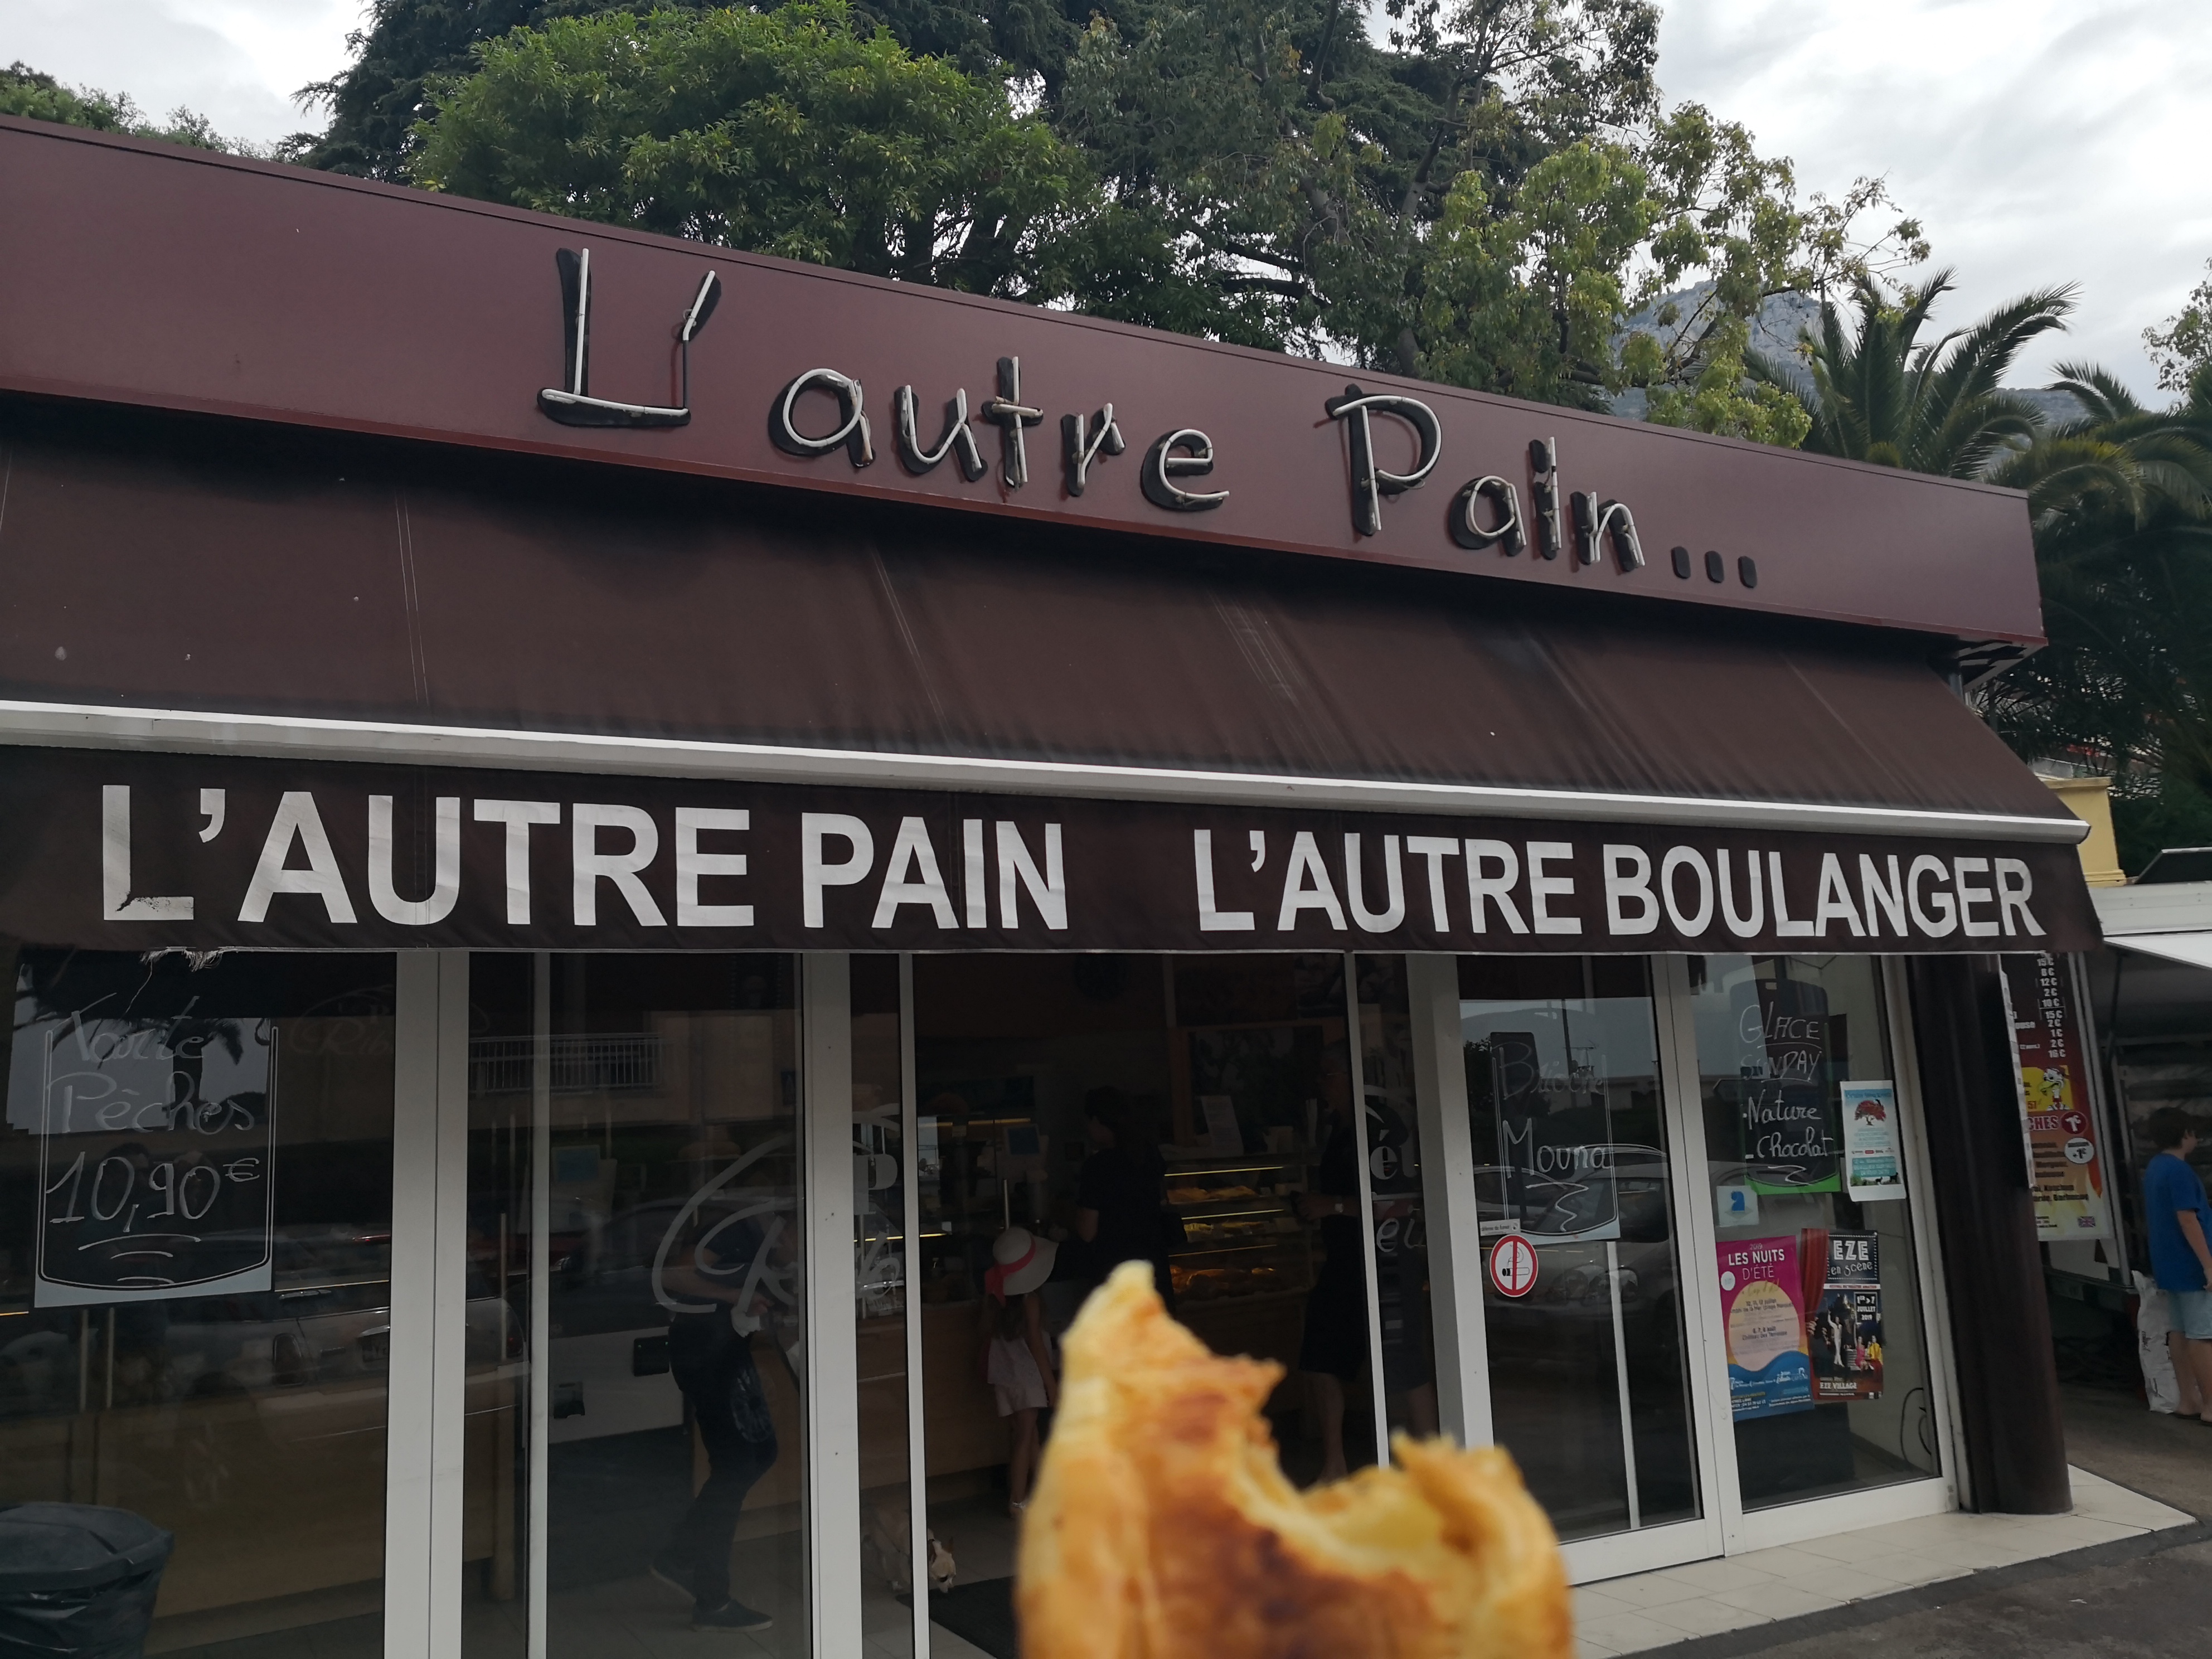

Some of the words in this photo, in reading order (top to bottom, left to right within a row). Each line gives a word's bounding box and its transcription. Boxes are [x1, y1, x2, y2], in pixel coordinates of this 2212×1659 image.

[103, 784, 754, 928] L'AUTRE
[802, 812, 1068, 930] PAIN
[1194, 829, 1582, 934] L'AUTRE
[1603, 843, 2047, 938] BOULANGER
[1739, 1001, 1820, 1043] GLACE
[1728, 1252, 1749, 1266] LES
[1752, 1249, 1785, 1264] NUITS
[1833, 1240, 1869, 1261] EZE
[1742, 1263, 1775, 1280] D'ÉTÉ
[1831, 1266, 1841, 1275] en
